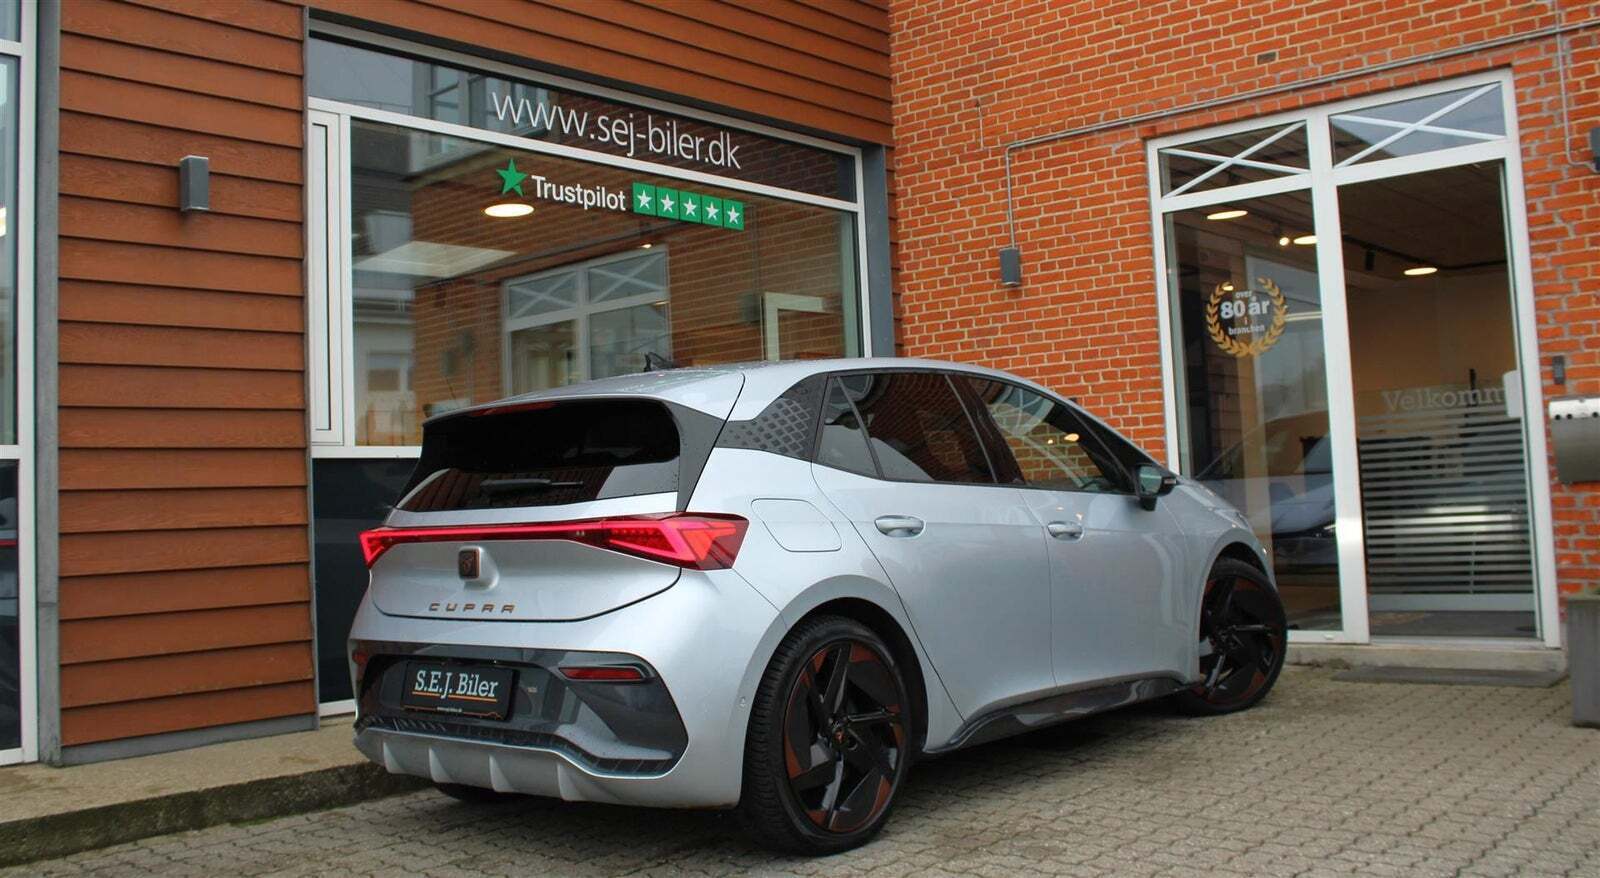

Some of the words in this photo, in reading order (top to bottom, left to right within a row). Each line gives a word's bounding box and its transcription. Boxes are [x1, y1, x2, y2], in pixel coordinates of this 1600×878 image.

[492, 91, 742, 170] www.sej-biler.dk
[531, 174, 627, 212] Trustpilot
[1220, 300, 1246, 319] 80
[1248, 295, 1270, 315] år
[428, 602, 516, 614] CUPRA
[414, 670, 453, 699] S.E.J.
[455, 672, 499, 698] Biler
